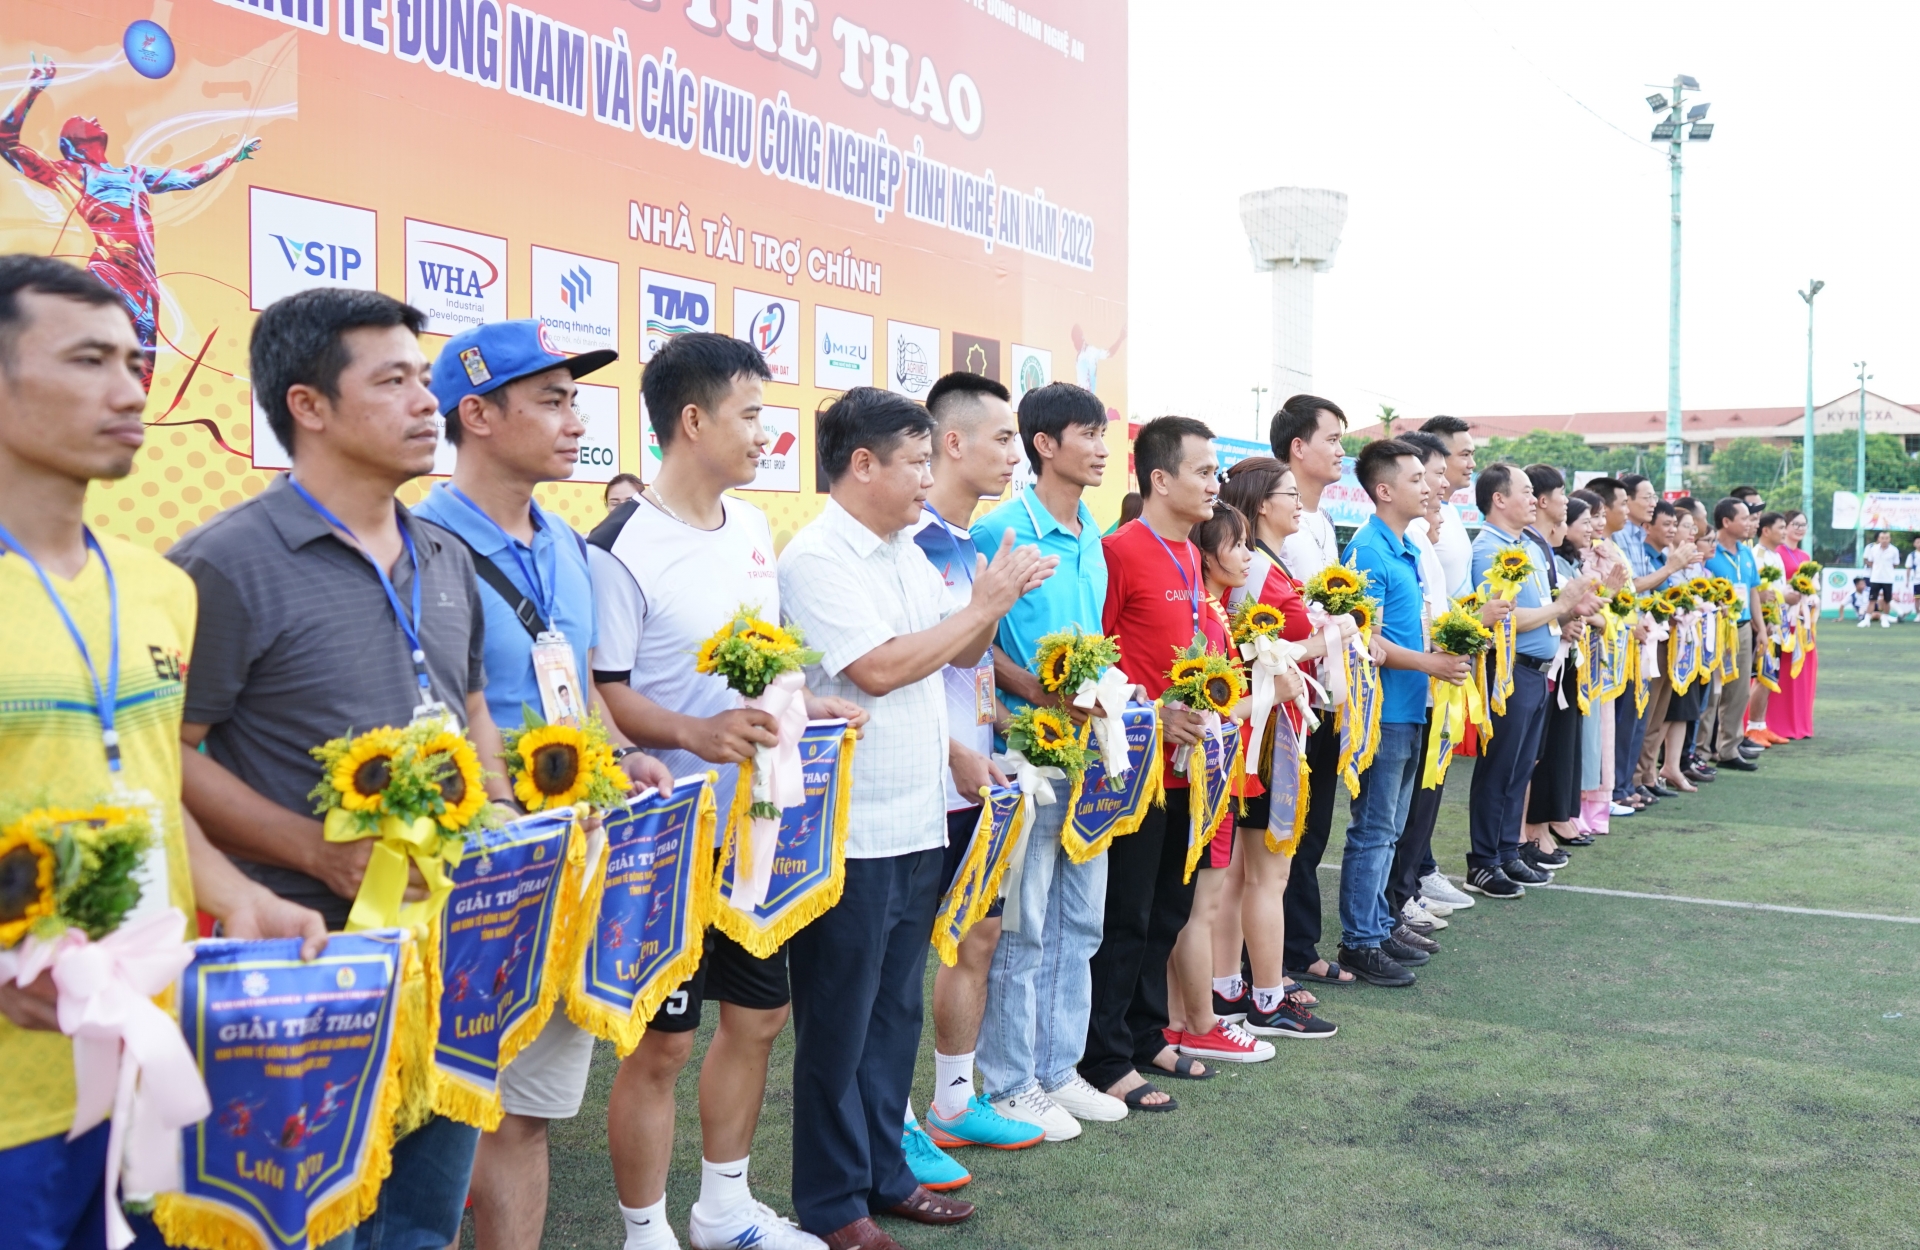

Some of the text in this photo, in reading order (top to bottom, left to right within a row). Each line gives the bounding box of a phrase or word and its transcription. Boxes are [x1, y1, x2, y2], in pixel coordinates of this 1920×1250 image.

[1017, 10, 1042, 41] NAM
[1070, 38, 1086, 63] AN
[832, 16, 982, 135] THAO
[509, 10, 585, 111] NAM
[594, 33, 631, 126] VÀ
[640, 52, 695, 145] CÁC
[702, 81, 753, 162] KHU
[759, 95, 822, 185] CÔNG
[826, 127, 901, 218] NGHIỆP
[904, 139, 947, 223] TỈNH
[950, 171, 996, 250] NGHỆ
[998, 189, 1021, 246] AN
[1024, 190, 1058, 258] NĂM
[1060, 211, 1094, 268] 2022
[268, 233, 362, 282] VSIP
[630, 201, 882, 295] NHÀ TÀI TRỢ CHÍNH
[418, 259, 484, 299] WHA
[429, 308, 485, 324] Development
[446, 298, 485, 313] Industrial
[646, 284, 710, 326] TMD
[1078, 798, 1122, 815] Lưu Niệm
[607, 853, 635, 873] GIẢI
[455, 890, 493, 915] GIẢI
[218, 1015, 277, 1043] GIẢI
[325, 1012, 378, 1033] THAO
